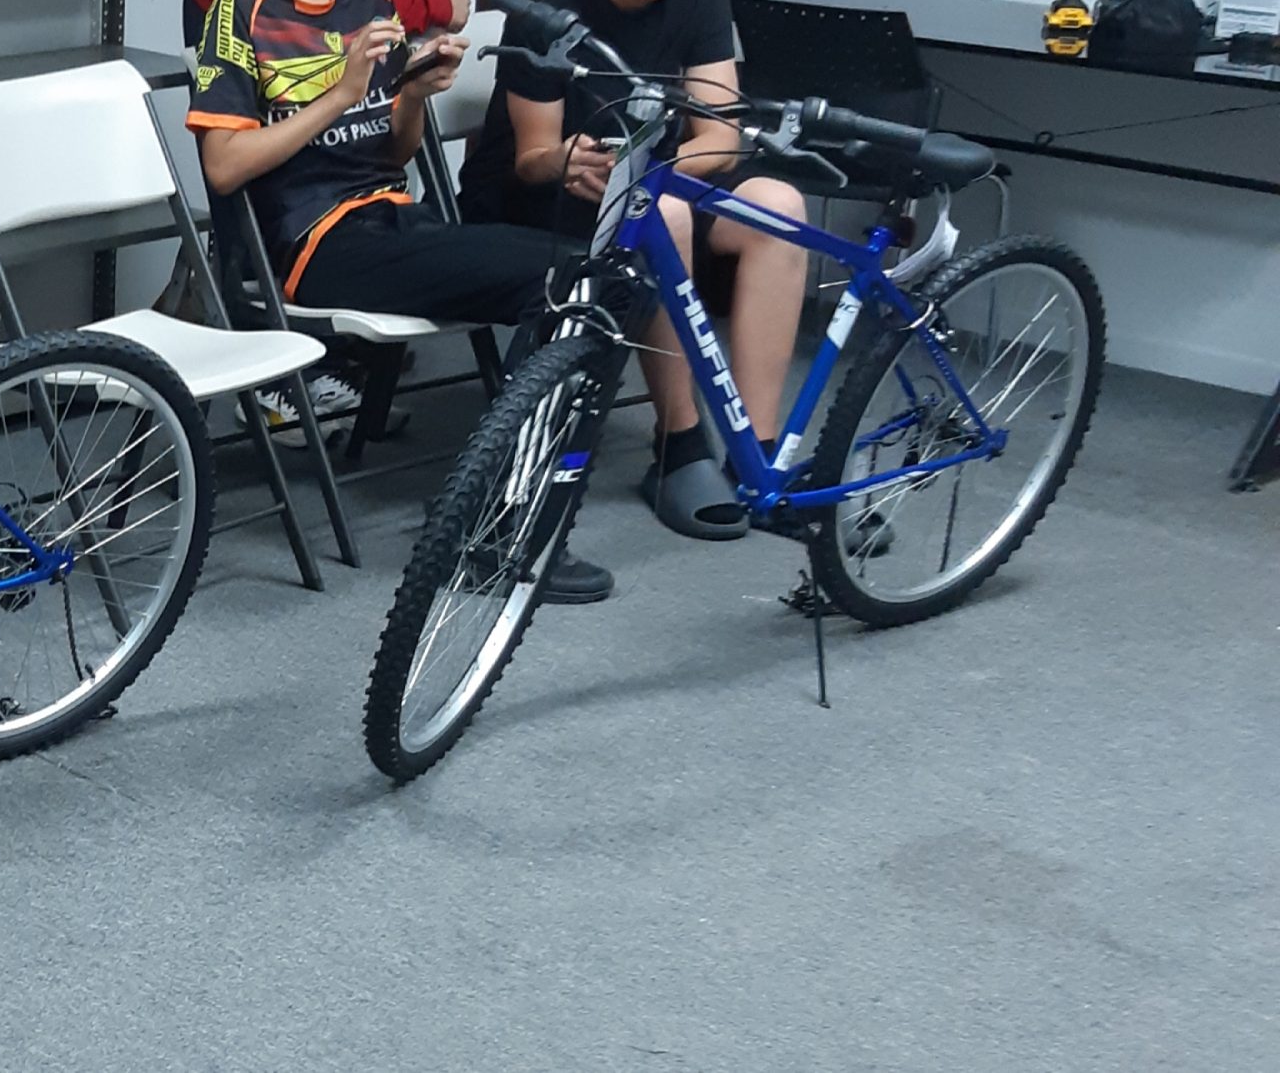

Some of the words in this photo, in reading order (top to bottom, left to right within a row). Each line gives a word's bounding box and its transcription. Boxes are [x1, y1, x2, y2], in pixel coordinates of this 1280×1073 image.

[323, 126, 349, 147] OF
[350, 114, 392, 142] PALES
[675, 279, 751, 433] HUFFY
